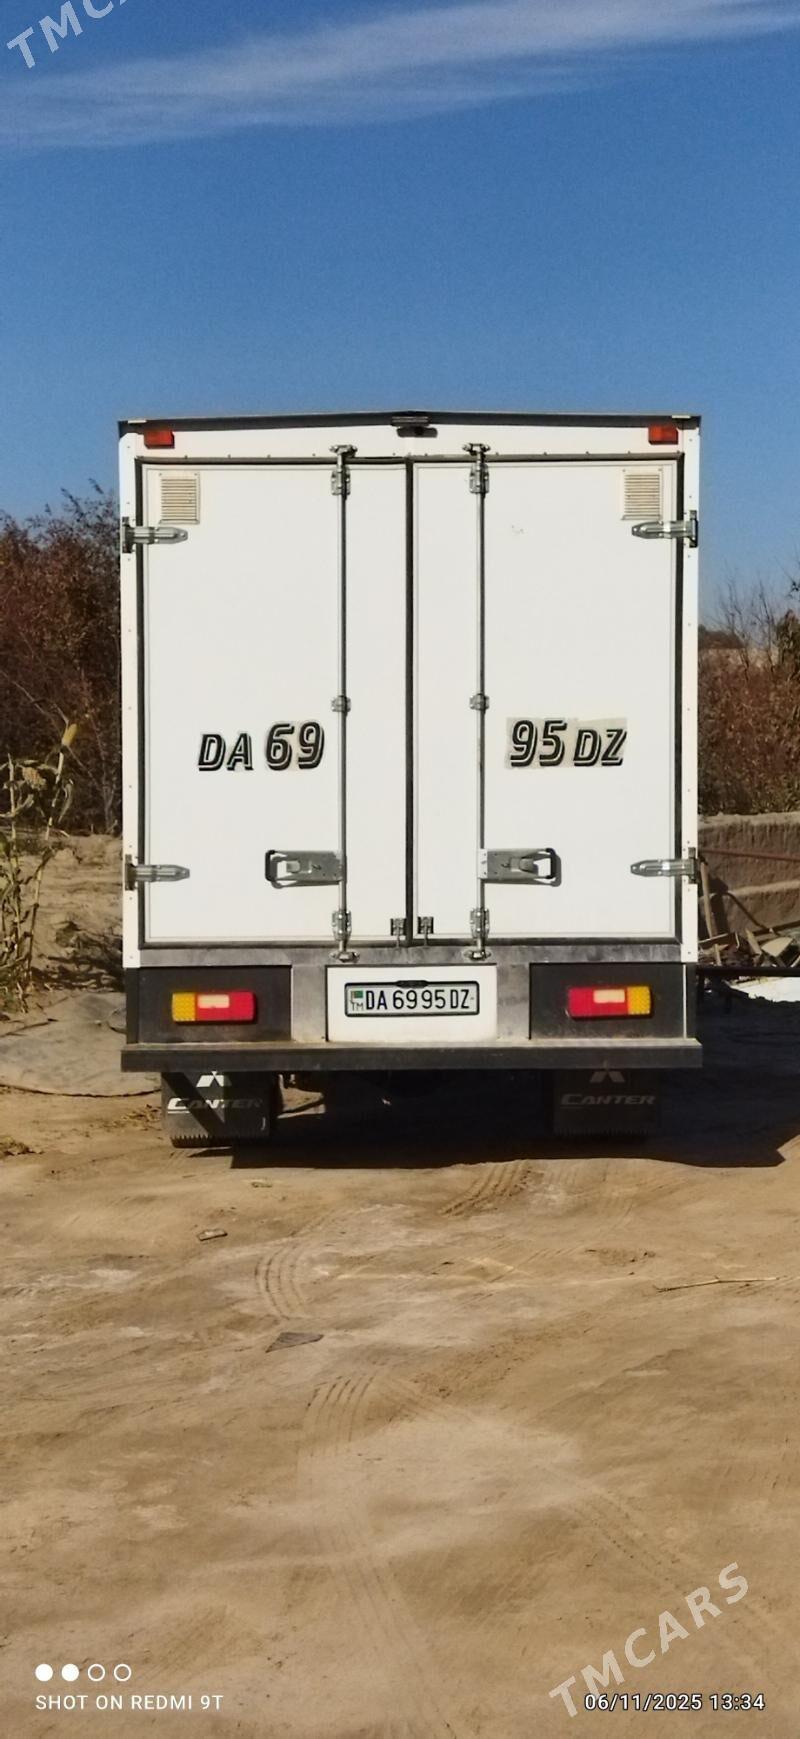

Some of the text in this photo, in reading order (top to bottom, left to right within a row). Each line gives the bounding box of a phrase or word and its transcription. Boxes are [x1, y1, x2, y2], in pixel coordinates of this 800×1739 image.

[198, 721, 325, 771] DA 69
[510, 720, 627, 767] 95 DZ
[365, 990, 388, 1010] DA
[450, 989, 470, 1009] DZ
[561, 1094, 656, 1105] CANTER
